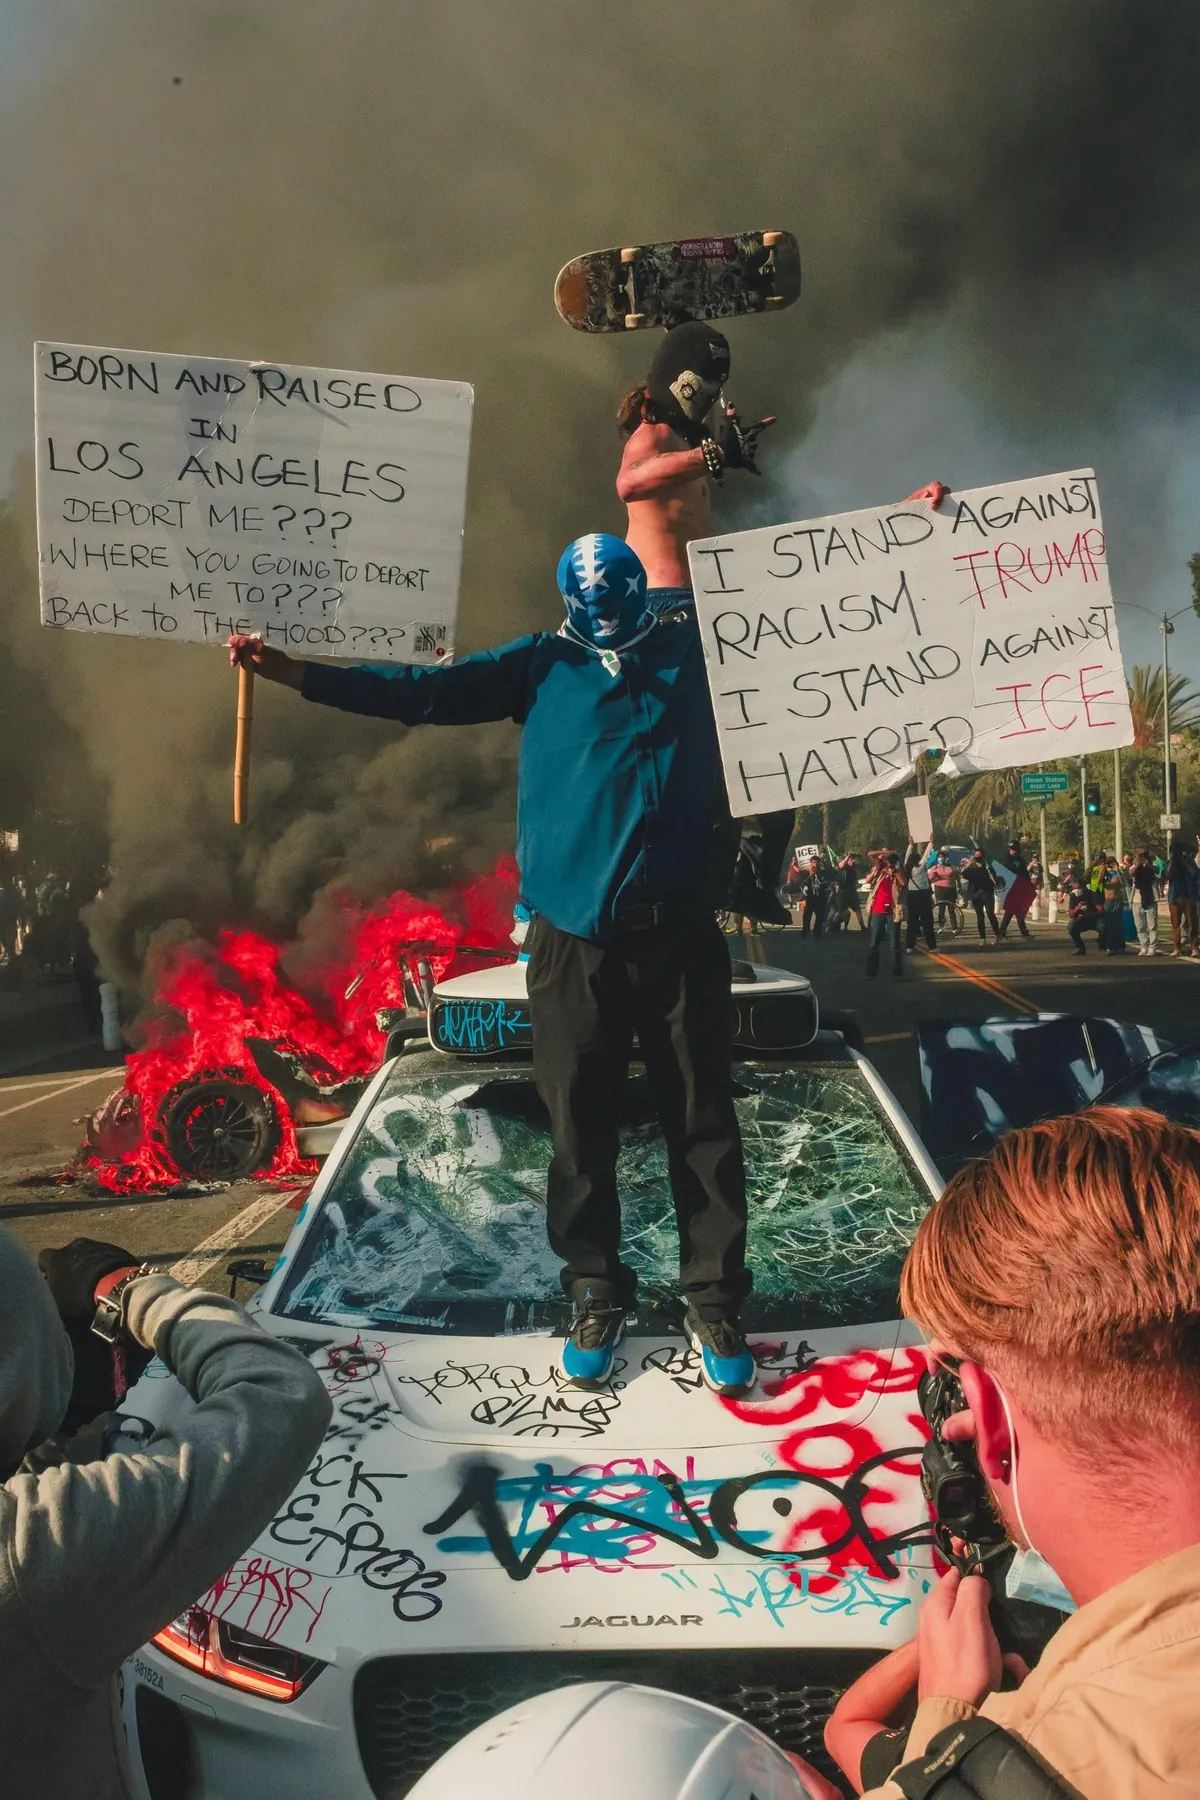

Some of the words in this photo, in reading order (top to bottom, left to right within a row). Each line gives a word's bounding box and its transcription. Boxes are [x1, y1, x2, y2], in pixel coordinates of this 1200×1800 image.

[44, 351, 160, 394] BORN
[174, 369, 246, 396] AND
[250, 366, 422, 413] RAISED
[189, 417, 238, 444] IN
[48, 437, 144, 481] LOS
[178, 453, 408, 503] ANGELES
[62, 497, 192, 529] DEPORT
[698, 547, 745, 594] I
[767, 511, 934, 579] STAND
[951, 476, 1098, 535] AGAINST
[48, 536, 170, 572] WHERE
[186, 546, 240, 575] YOU
[252, 553, 331, 580] GOING
[334, 558, 358, 584] TO
[365, 561, 430, 592] DEPORT
[170, 582, 213, 603] ME
[953, 528, 1107, 609] TRUMP
[44, 596, 130, 628] BACK
[194, 609, 251, 637] THE
[265, 620, 407, 657] HOOD???
[719, 688, 768, 731] I
[787, 644, 961, 718] STAND
[980, 605, 1114, 667] AGAINST
[995, 665, 1116, 740] ICE
[560, 1614, 704, 1629] JAGUAR
